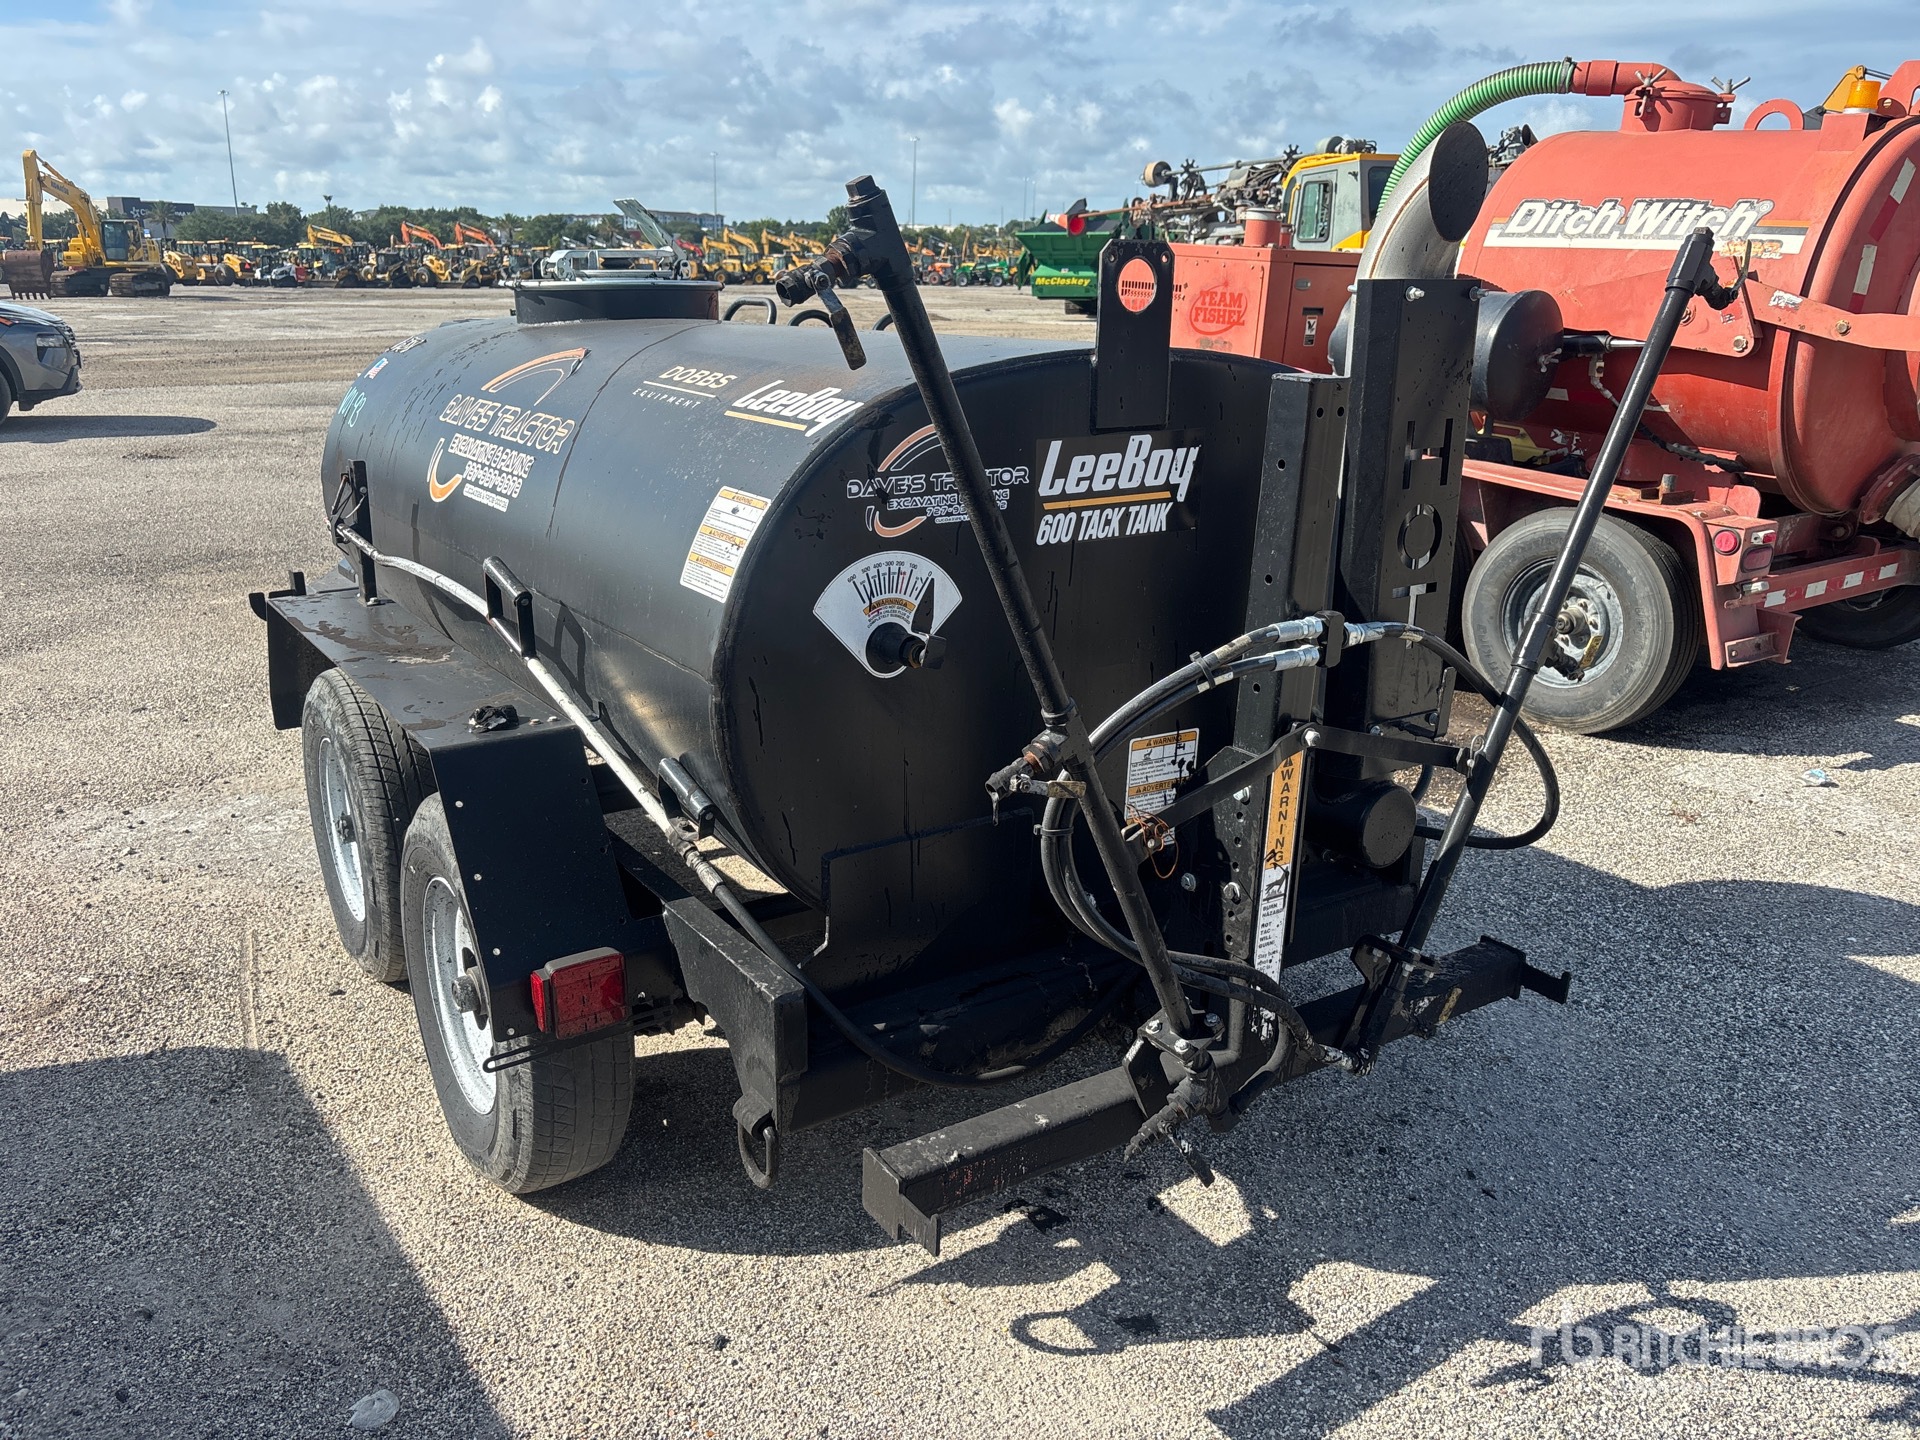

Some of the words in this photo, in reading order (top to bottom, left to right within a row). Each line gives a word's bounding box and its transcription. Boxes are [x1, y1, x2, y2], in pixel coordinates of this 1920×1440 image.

[1503, 199, 1622, 236] Ditch
[1625, 199, 1758, 237] Witch
[1035, 277, 1091, 287] McCloskey
[1199, 290, 1243, 308] TEAM
[1193, 306, 1245, 326] FISHEL
[658, 366, 738, 388] DOBBS
[632, 388, 701, 409] EQUIPMENT
[732, 379, 864, 437] LeeBoy
[488, 404, 576, 455] TRACTOR
[448, 432, 498, 465] EXCAVATING
[1038, 434, 1200, 502] LeeBoy
[847, 474, 926, 499] DAVE'S
[930, 466, 1030, 493] TRTOR
[886, 493, 958, 511] EXCAVATING
[1036, 511, 1077, 546] 600
[1078, 506, 1126, 541] TACK
[1125, 502, 1174, 536] TANK
[909, 562, 918, 570] 100
[1153, 734, 1183, 746] WARNING
[1273, 768, 1294, 862] WARNING
[1261, 908, 1284, 918] HAZARD
[1262, 902, 1278, 912] BURN
[1260, 921, 1272, 929] HOT
[1260, 928, 1271, 936] TAC
